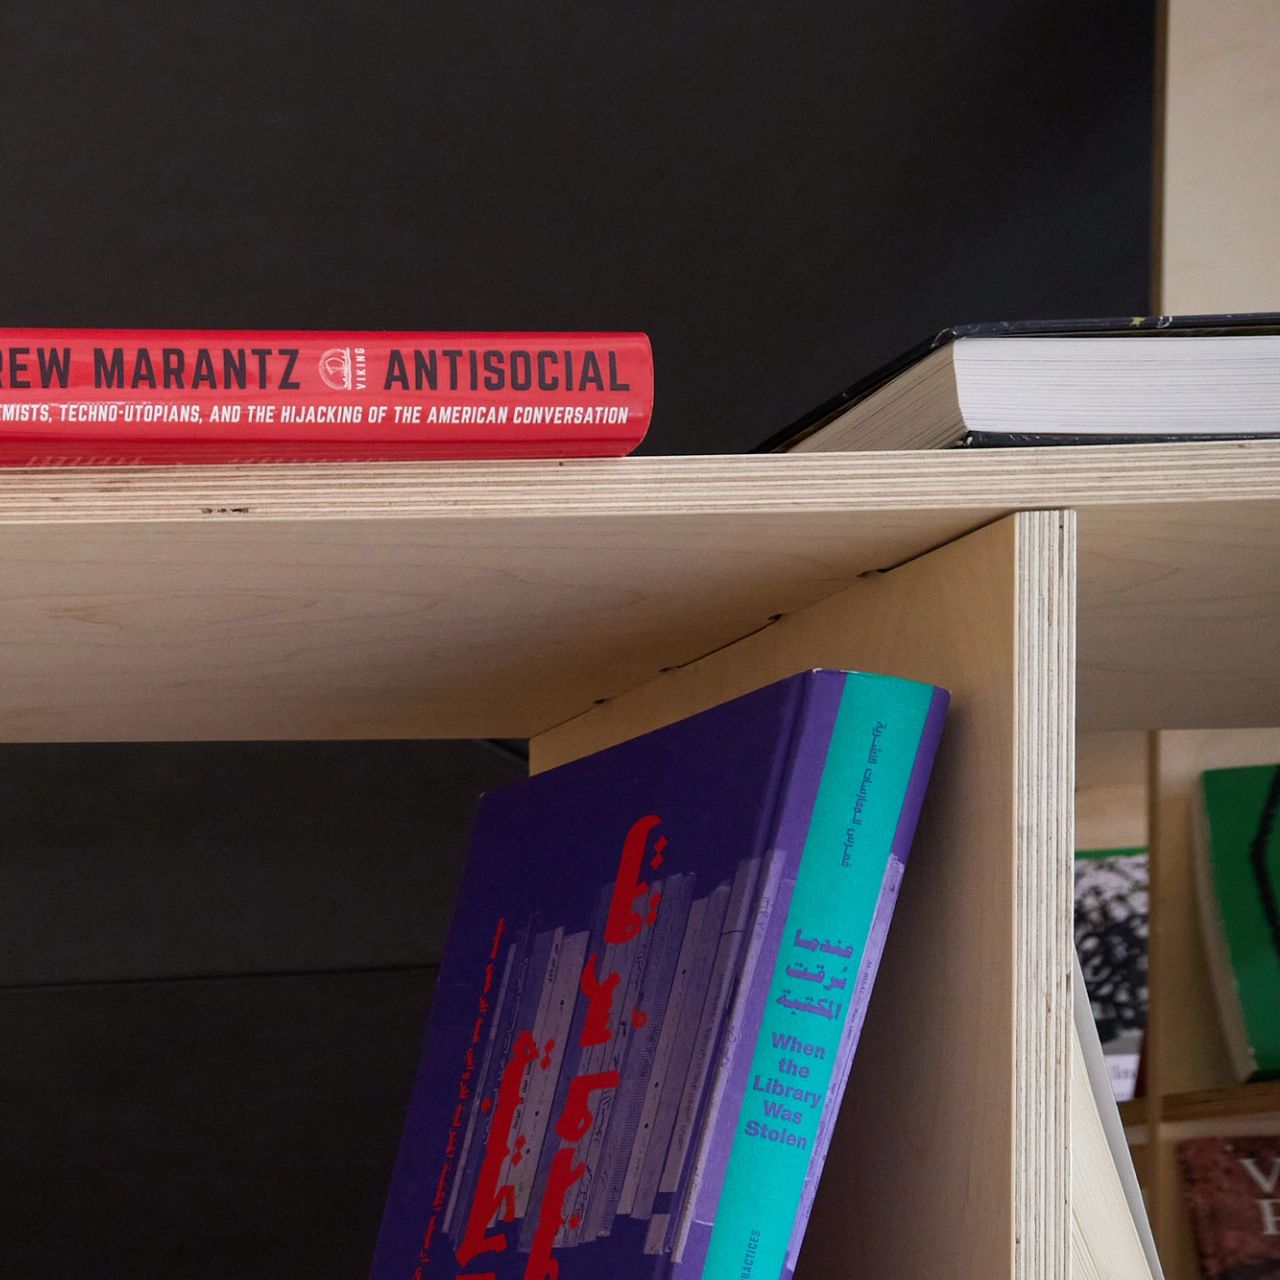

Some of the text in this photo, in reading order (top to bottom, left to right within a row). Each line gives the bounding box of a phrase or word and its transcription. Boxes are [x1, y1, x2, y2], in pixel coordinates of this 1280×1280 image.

[93, 348, 300, 390] MARANTZ
[355, 347, 367, 390] VIKING
[383, 349, 630, 391] ANTISOCIAL
[59, 404, 203, 425] TECHNO-UTOPIANS,
[209, 405, 241, 423] AND
[247, 405, 274, 423] THE
[280, 405, 363, 424] HIJACKING
[368, 405, 387, 423] OF
[393, 406, 421, 424] THE
[427, 406, 507, 424] AMERICAN
[513, 406, 629, 424] CONVERSATION
[794, 928, 853, 959] عندما
[776, 989, 843, 1020] المكتبة
[772, 1031, 826, 1060] When
[779, 1058, 810, 1079] the
[752, 1075, 822, 1108] Library
[763, 1101, 803, 1125] Was
[744, 1120, 808, 1150] Stolen
